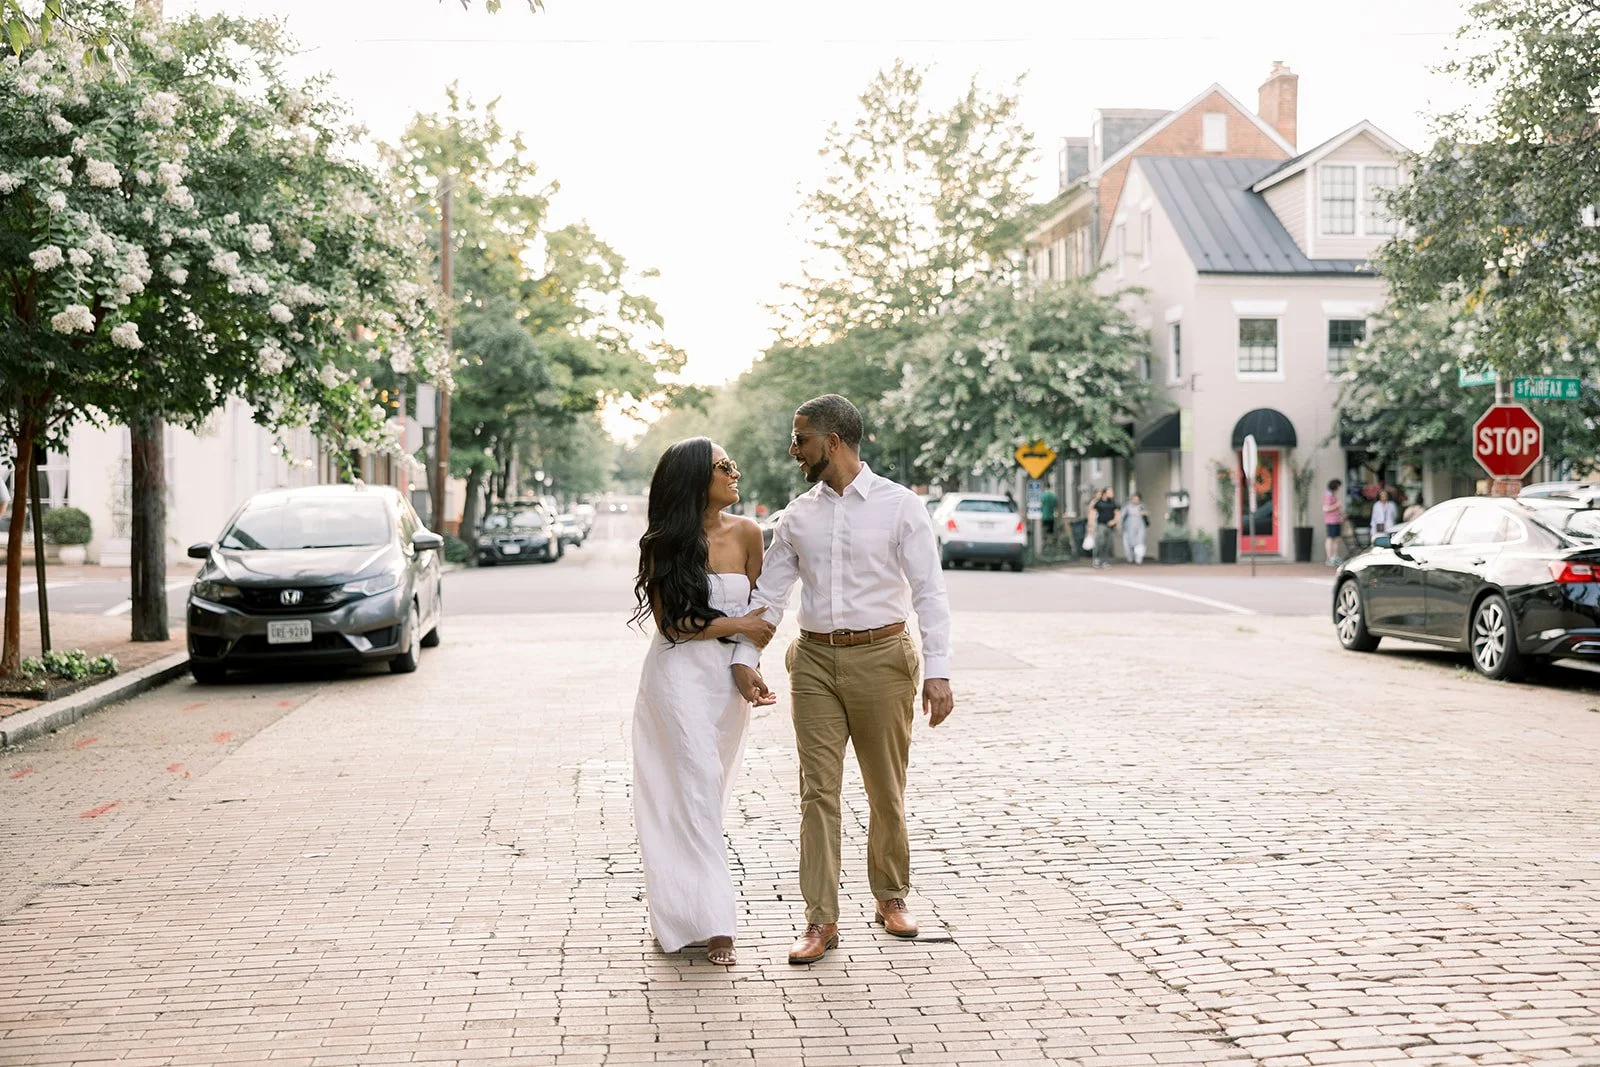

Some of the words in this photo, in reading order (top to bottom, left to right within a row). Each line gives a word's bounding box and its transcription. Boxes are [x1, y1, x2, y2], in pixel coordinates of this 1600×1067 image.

[1516, 381, 1524, 394] S
[1524, 380, 1562, 397] FAIRFAX
[1478, 427, 1538, 455] STOP
